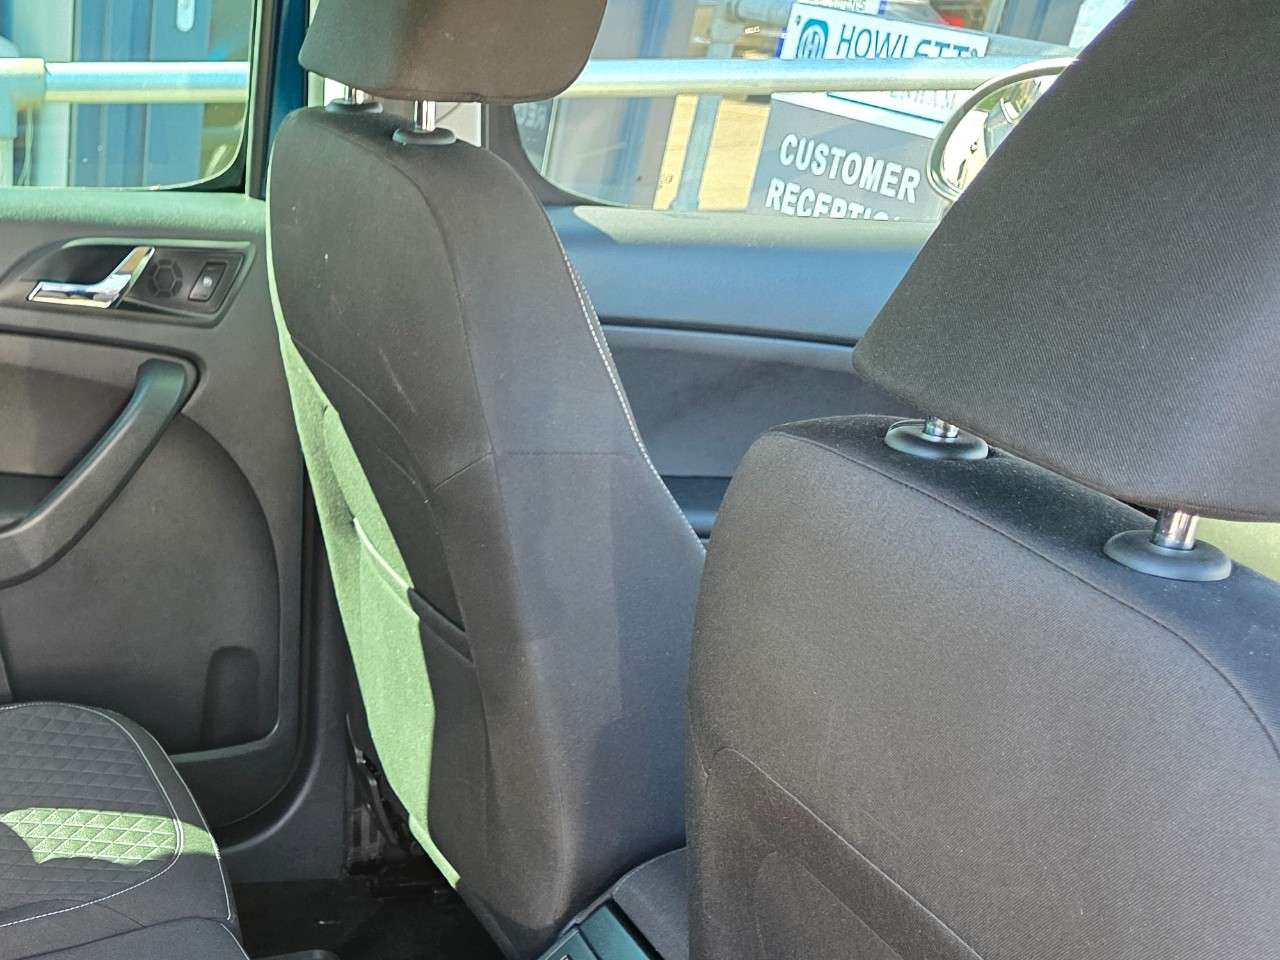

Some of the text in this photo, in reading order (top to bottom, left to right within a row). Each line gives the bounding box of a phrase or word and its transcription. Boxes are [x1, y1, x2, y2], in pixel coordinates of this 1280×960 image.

[836, 24, 978, 58] HOWLETT
[780, 134, 921, 203] CUSTOMER
[766, 177, 900, 221] RECEPT
